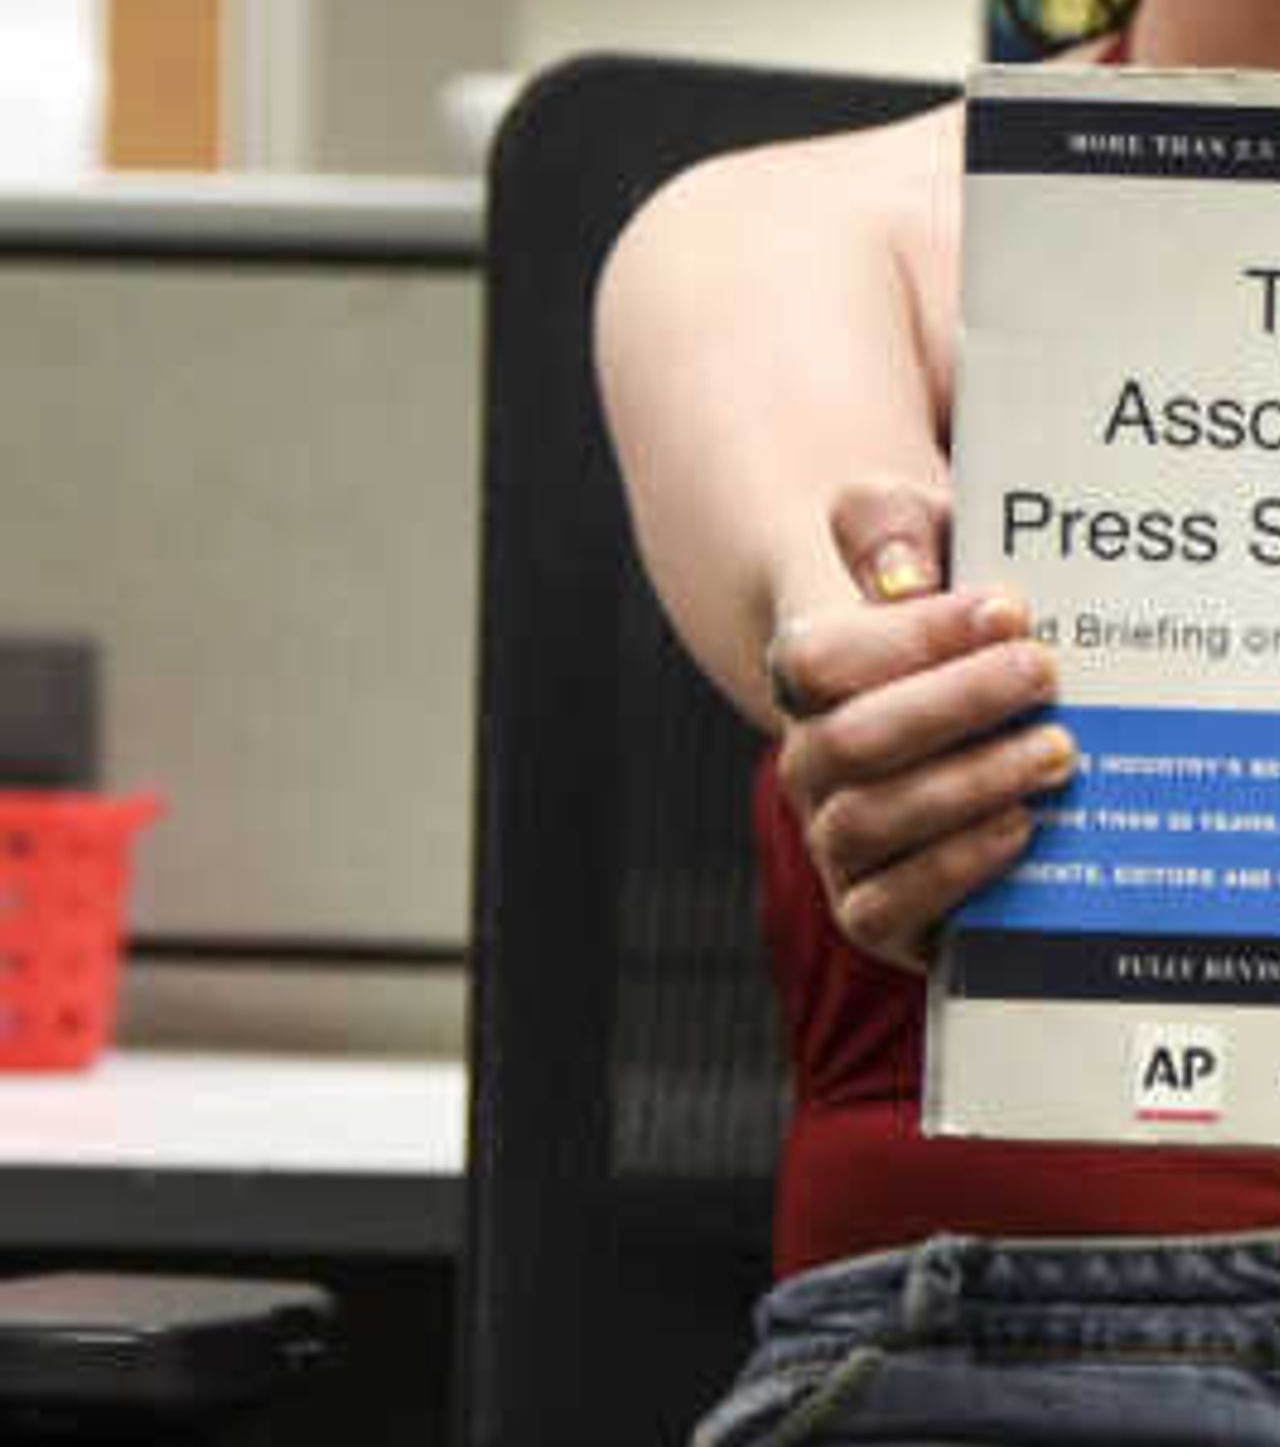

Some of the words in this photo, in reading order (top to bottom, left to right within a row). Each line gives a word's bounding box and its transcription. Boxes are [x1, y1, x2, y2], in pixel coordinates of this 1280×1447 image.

[1154, 133, 1228, 160] THAN
[1002, 492, 1219, 562] Press
[1076, 611, 1230, 659] Briefing
[1117, 955, 1194, 980] FULLY
[1143, 1047, 1217, 1091] AP
